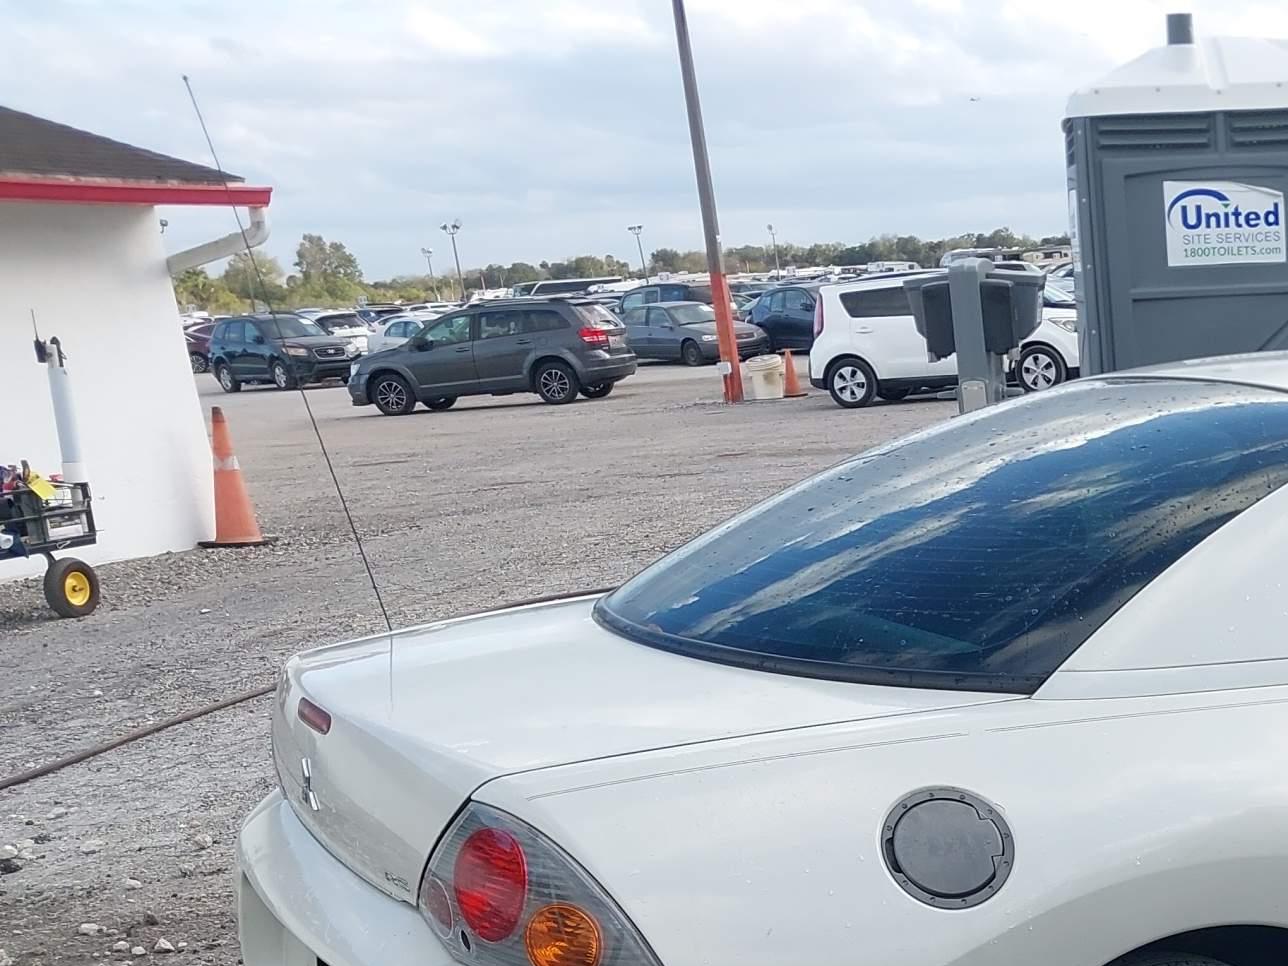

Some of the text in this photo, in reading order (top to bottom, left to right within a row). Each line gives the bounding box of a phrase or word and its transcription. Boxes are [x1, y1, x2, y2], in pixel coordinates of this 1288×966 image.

[1181, 202, 1280, 230] United
[1182, 231, 1281, 245] SITE SERVICES
[1184, 246, 1282, 257] 1800TOILETS.com
